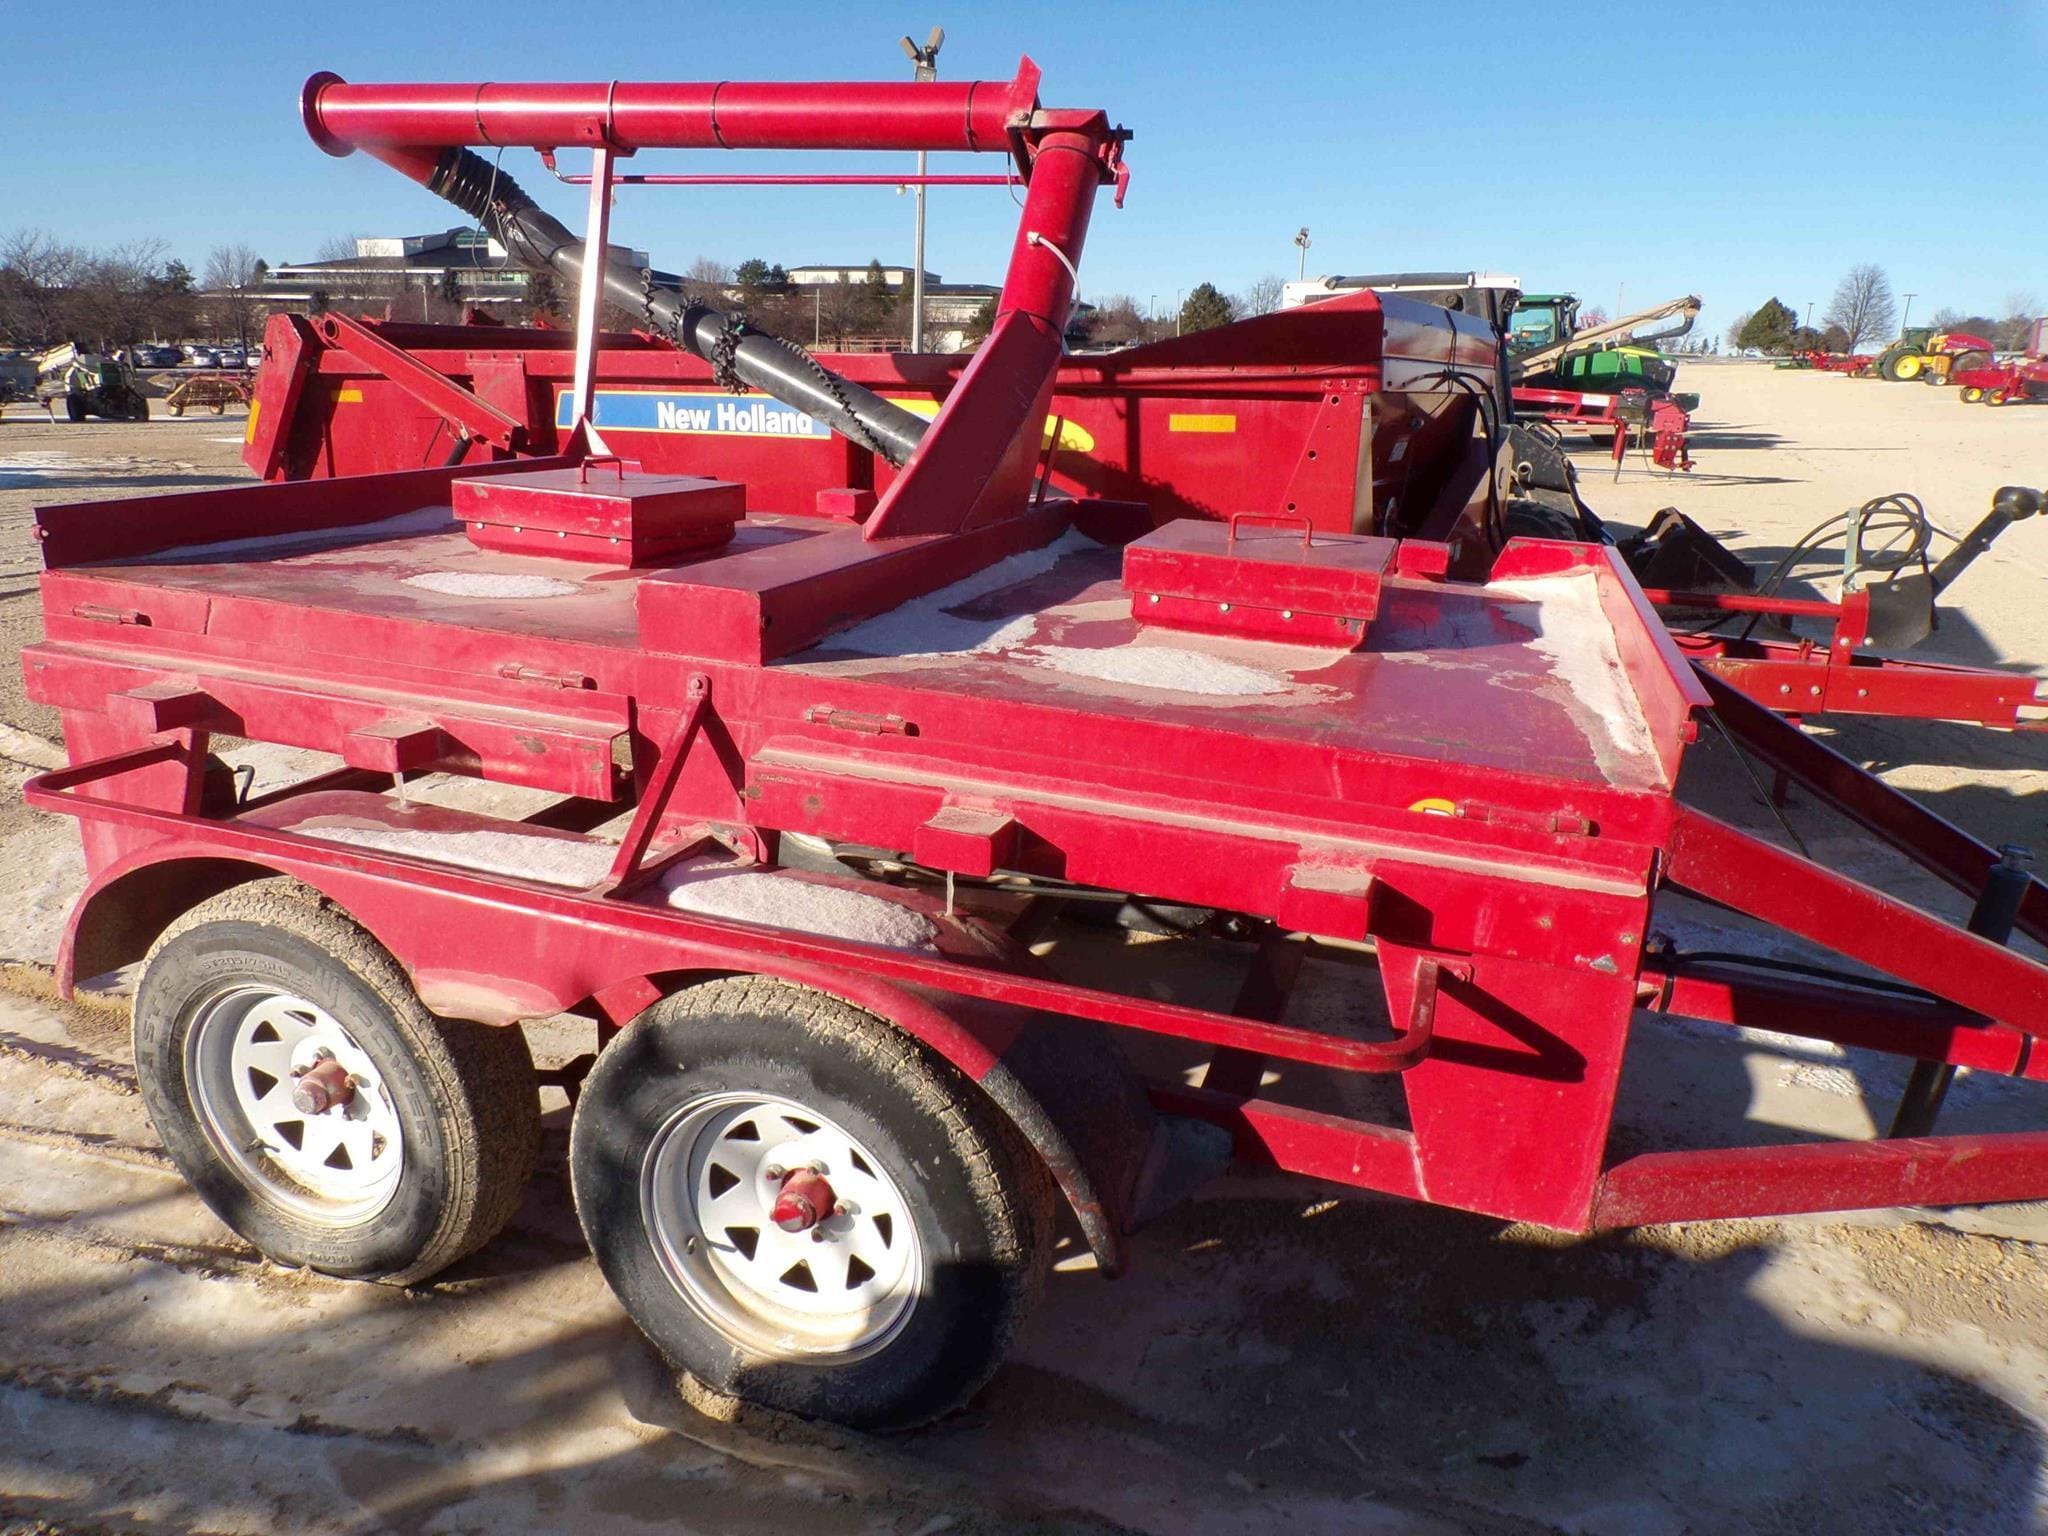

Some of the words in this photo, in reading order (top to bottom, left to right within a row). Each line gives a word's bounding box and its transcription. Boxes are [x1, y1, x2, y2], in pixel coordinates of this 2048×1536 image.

[657, 402, 710, 430] New
[717, 403, 813, 434] Holland
[349, 1003, 432, 1147] POWER
